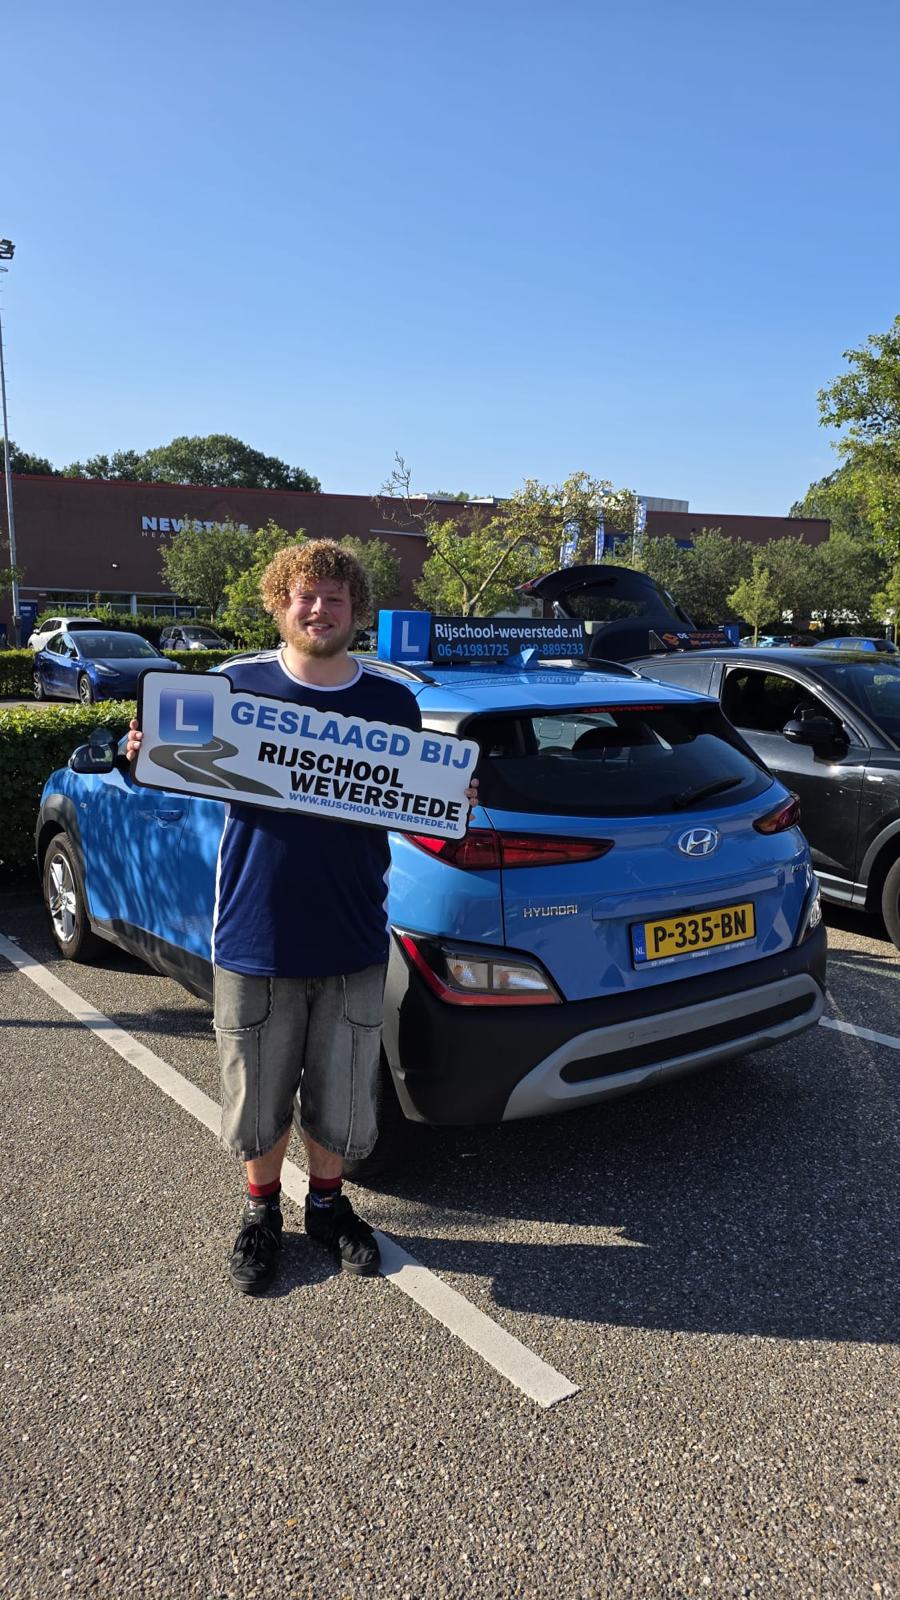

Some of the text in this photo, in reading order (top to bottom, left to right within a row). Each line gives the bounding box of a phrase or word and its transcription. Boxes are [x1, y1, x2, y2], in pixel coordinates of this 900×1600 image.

[141, 515, 249, 535] NEWSTYE
[141, 531, 178, 539] HEAL
[401, 620, 420, 653] L
[434, 623, 583, 641] Rijschool-weverstede.nl
[437, 643, 510, 657] 06-41981725
[175, 698, 200, 731] L
[230, 701, 472, 769] GESLAAGD BIJ
[257, 741, 404, 789] RIJSCHOOL
[288, 792, 459, 832] WWW.RIJSCHOOL-WEVERSTEDE.NL
[290, 770, 463, 822] WEVERSTEDE
[523, 904, 578, 918] HYUNDAI
[653, 909, 747, 953] P-335-BN
